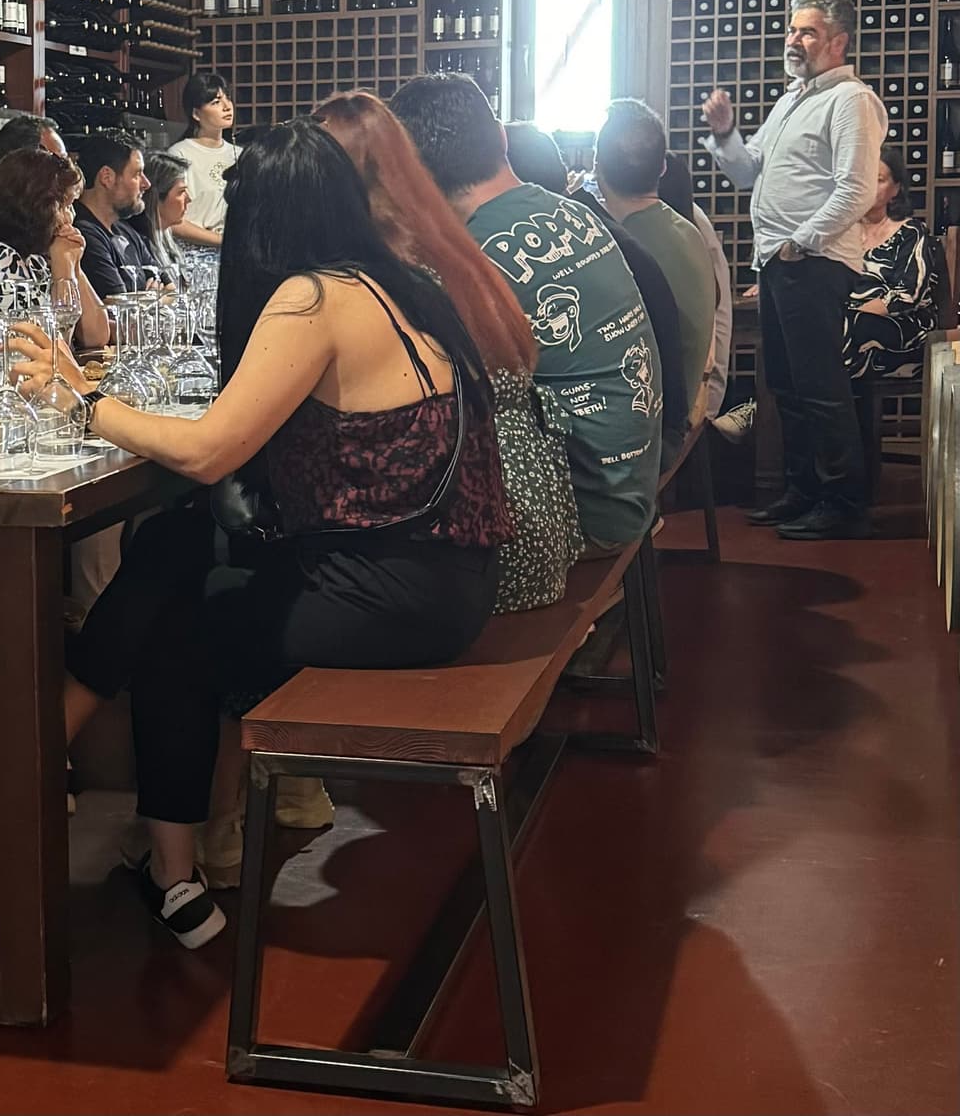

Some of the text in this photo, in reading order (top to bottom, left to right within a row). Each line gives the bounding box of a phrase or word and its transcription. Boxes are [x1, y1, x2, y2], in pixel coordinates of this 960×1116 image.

[552, 266, 574, 281] WELL
[596, 322, 616, 334] TWO
[570, 392, 590, 404] NOT
